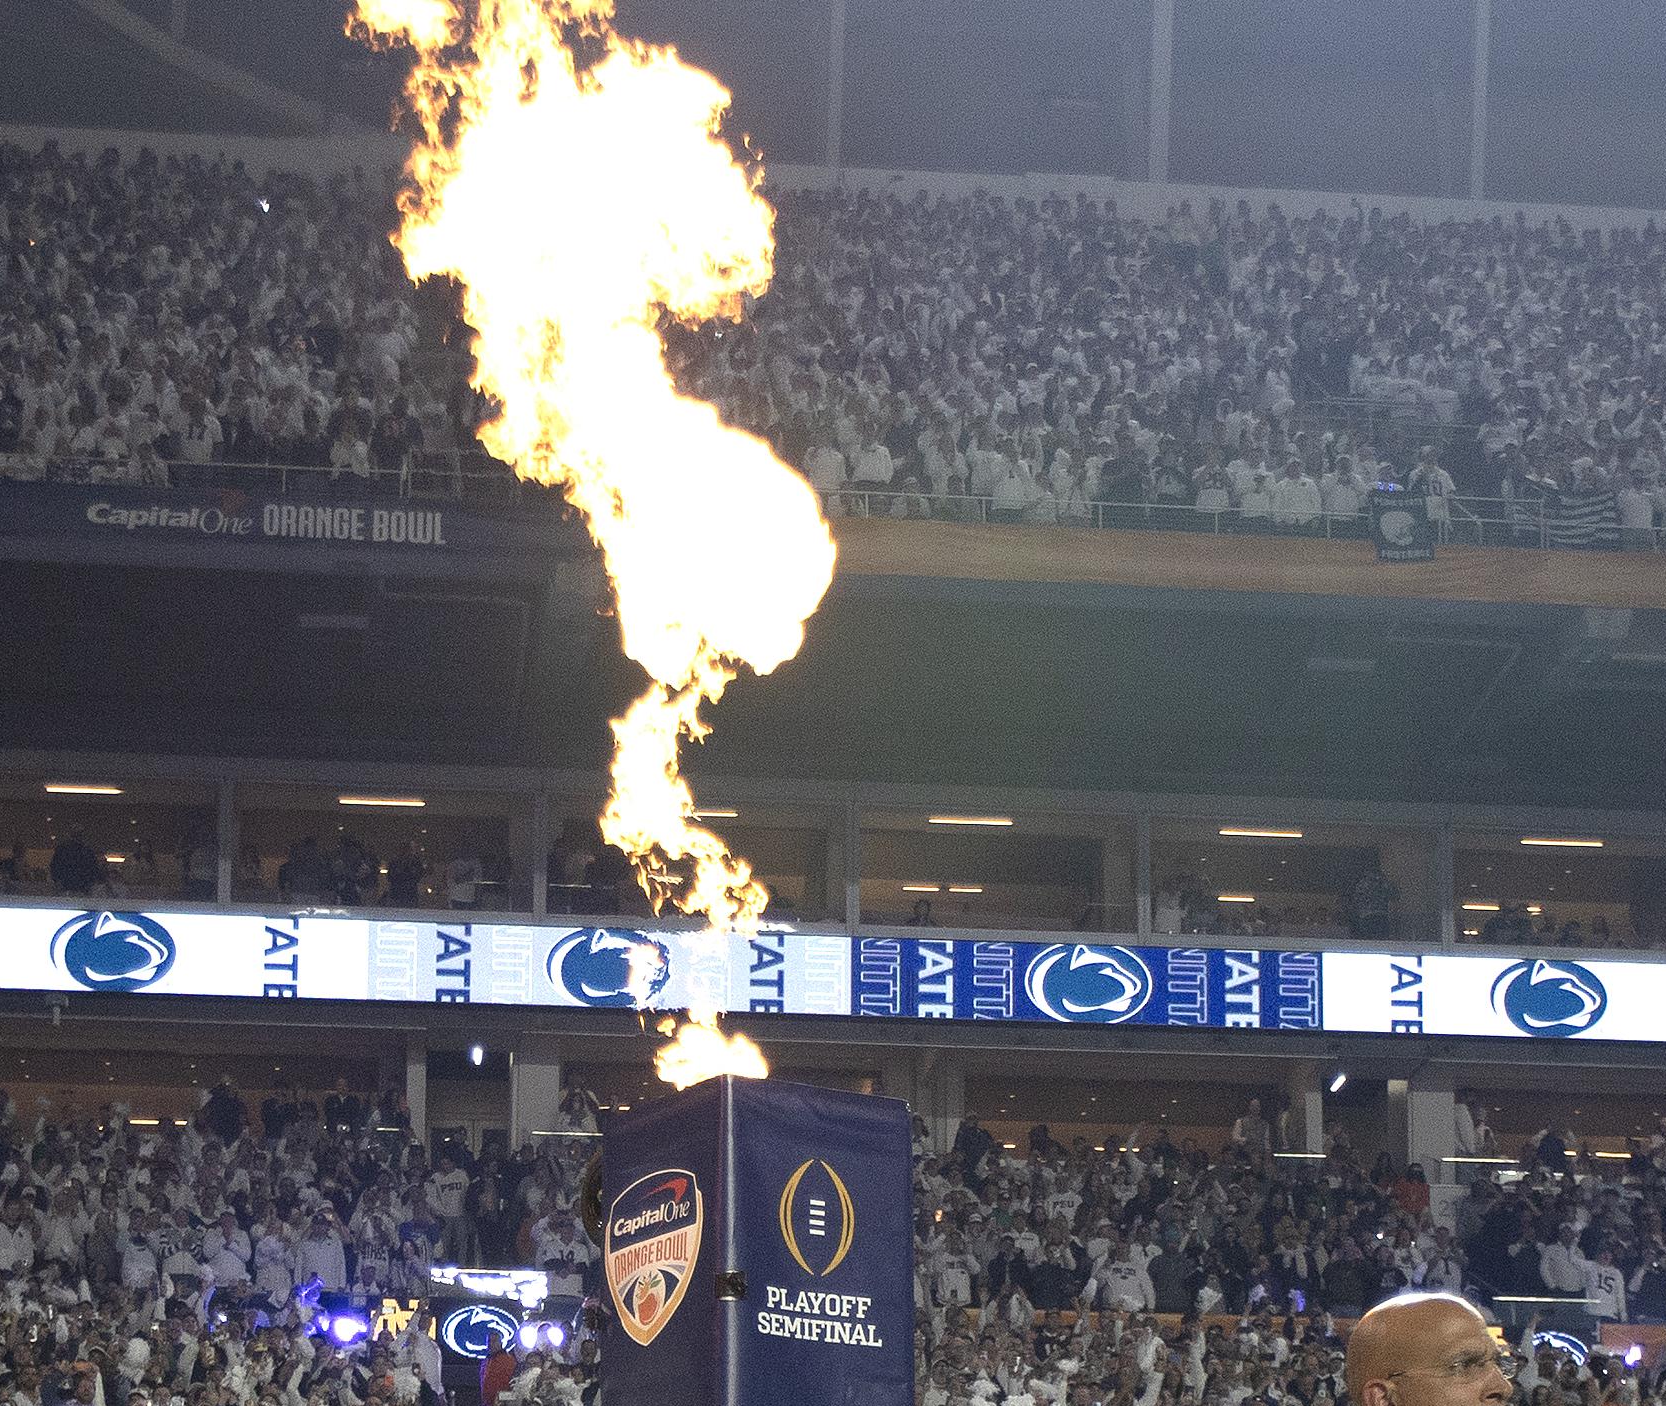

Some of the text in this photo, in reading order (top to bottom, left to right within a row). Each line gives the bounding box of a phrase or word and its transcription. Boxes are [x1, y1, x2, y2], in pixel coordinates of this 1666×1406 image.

[263, 504, 365, 541] ORANGE
[372, 508, 446, 546] BOWL
[613, 1230, 689, 1288] ORANGE BOWL
[766, 1286, 872, 1319] PLAYOFF
[757, 1312, 883, 1348] SEMIFINAL
